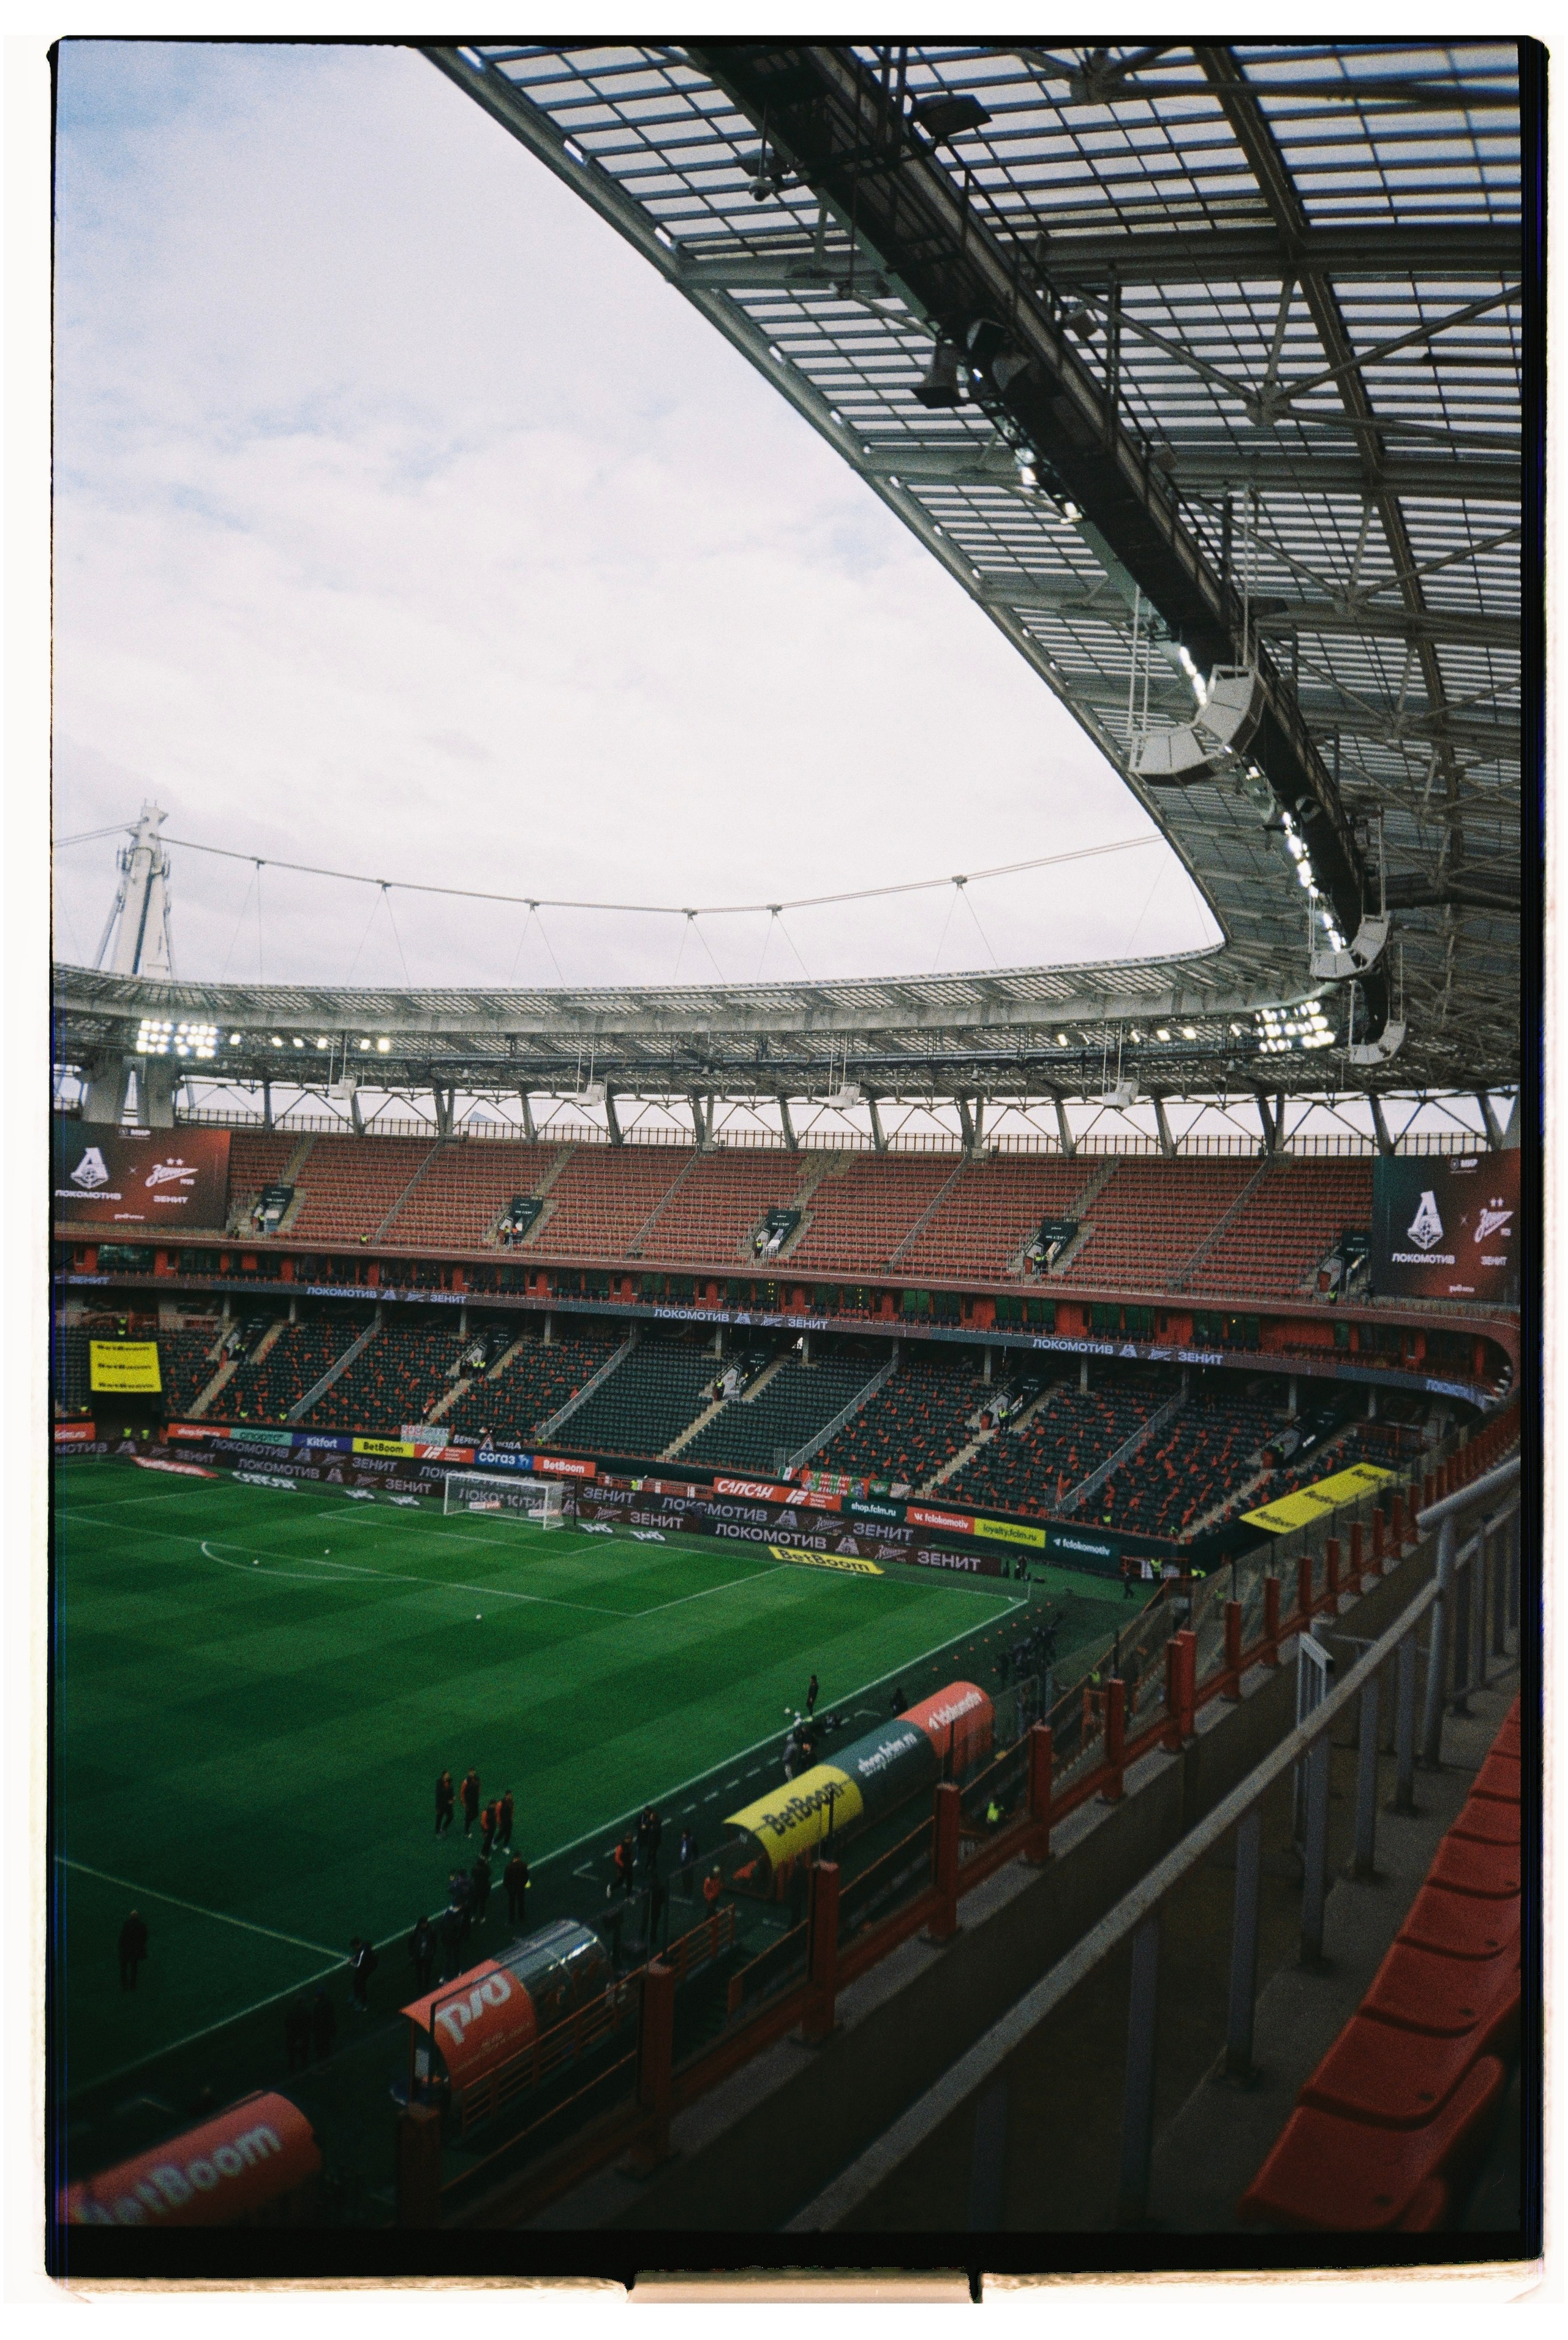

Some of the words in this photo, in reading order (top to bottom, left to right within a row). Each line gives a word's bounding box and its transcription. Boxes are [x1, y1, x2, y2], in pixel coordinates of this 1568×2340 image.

[1392, 1253, 1455, 1265] ЛОКОМОТИВ
[306, 1286, 377, 1299] ЛОКОМОТИВ
[430, 1294, 467, 1304] ЗЕНИТ
[654, 1308, 729, 1323] ЛОКОМОТИВ
[788, 1318, 828, 1330] ЗЕНИТ
[1033, 1338, 1113, 1354] ЛОКОМОТИВ
[1178, 1352, 1224, 1365] ЗЕНИТ
[306, 1436, 337, 1449] Kitfort
[363, 1440, 404, 1455] BetBoom
[175, 1448, 215, 1464] ЗЕНИТ
[211, 1439, 290, 1459] ЛОКОМОТИВ
[352, 1457, 397, 1473] ЗЕНИТ
[238, 1458, 320, 1479] ЛОКОМОТИВ
[385, 1478, 431, 1495] ЗЕНИТ
[543, 1460, 586, 1474] BetBoom
[582, 1487, 636, 1504] ЗЕНИТ
[717, 1479, 775, 1499] САПСАН
[851, 1501, 897, 1517] shop.fclm.ru
[630, 1511, 684, 1530] ЗЕНИТ
[853, 1522, 913, 1542] ЗЕНИТ
[715, 1523, 827, 1550] ЛОКОМОТИВ
[917, 1550, 981, 1572] ЗЕНИТ
[777, 1547, 870, 1573] BetBoom
[761, 1781, 845, 1837] BetBoom
